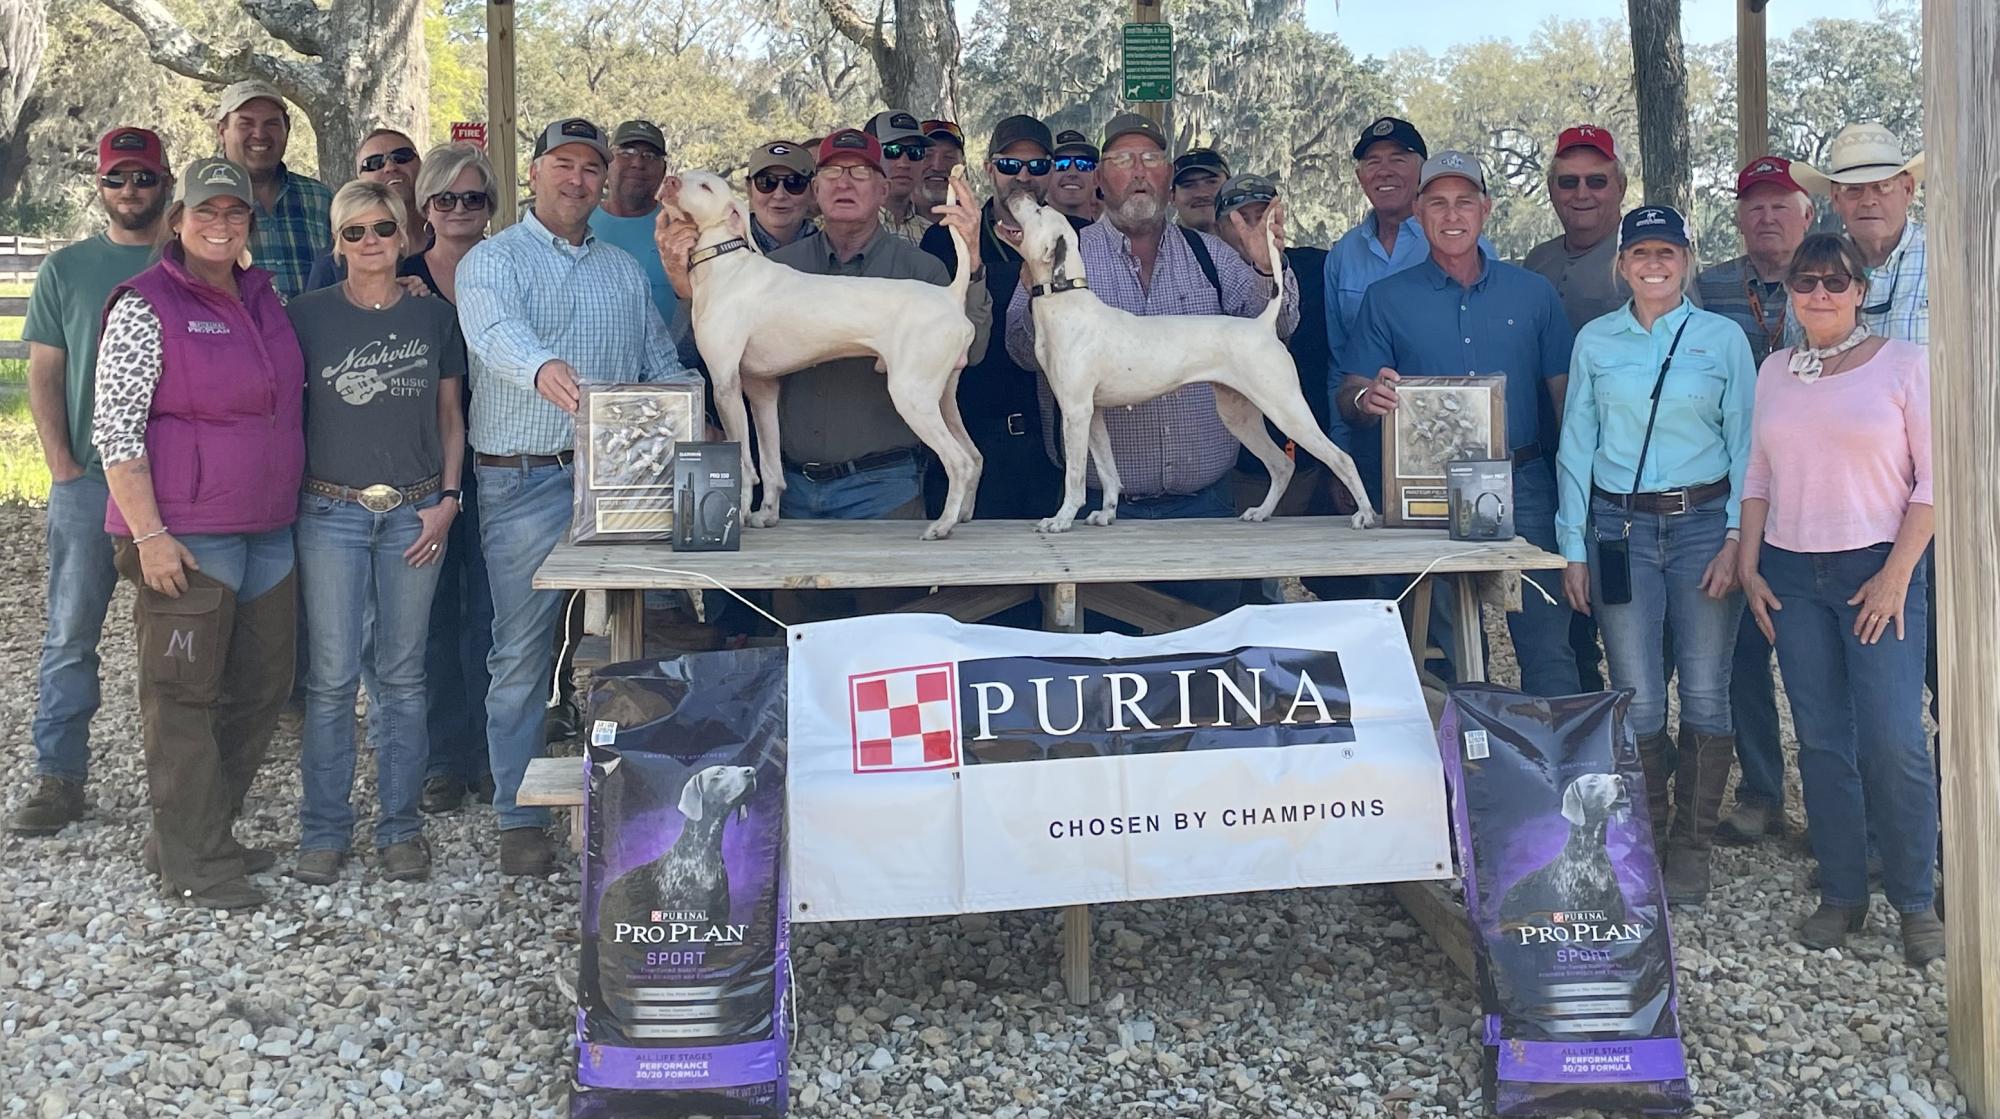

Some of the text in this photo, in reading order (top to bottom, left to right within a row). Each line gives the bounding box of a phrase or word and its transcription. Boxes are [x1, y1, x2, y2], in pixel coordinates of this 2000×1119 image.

[458, 129, 481, 138] FIRE
[322, 338, 430, 378] Nashville
[390, 377, 429, 389] MUSIC
[390, 387, 422, 397] CITY
[164, 629, 196, 663] M
[969, 667, 1338, 742] PURINA
[1049, 799, 1386, 839] CHOSEN BY CHAMPIONS
[662, 911, 704, 921] PURINA
[1564, 912, 1602, 922] PURINA
[613, 922, 744, 944] PRO PLAN
[1518, 923, 1641, 946] PRO PLAN
[646, 951, 706, 966] SPORT
[1556, 949, 1611, 963] SPORT
[1561, 1046, 1633, 1056] ALL LIFE STAGES
[636, 1052, 713, 1061] ALL LIFE STAGES
[1565, 1055, 1631, 1065] PERFORMANCE
[639, 1061, 709, 1071] PERFORMANCE
[1562, 1063, 1632, 1073] 30/20 FORMULA
[635, 1070, 710, 1079] 30/20 FORMULA
